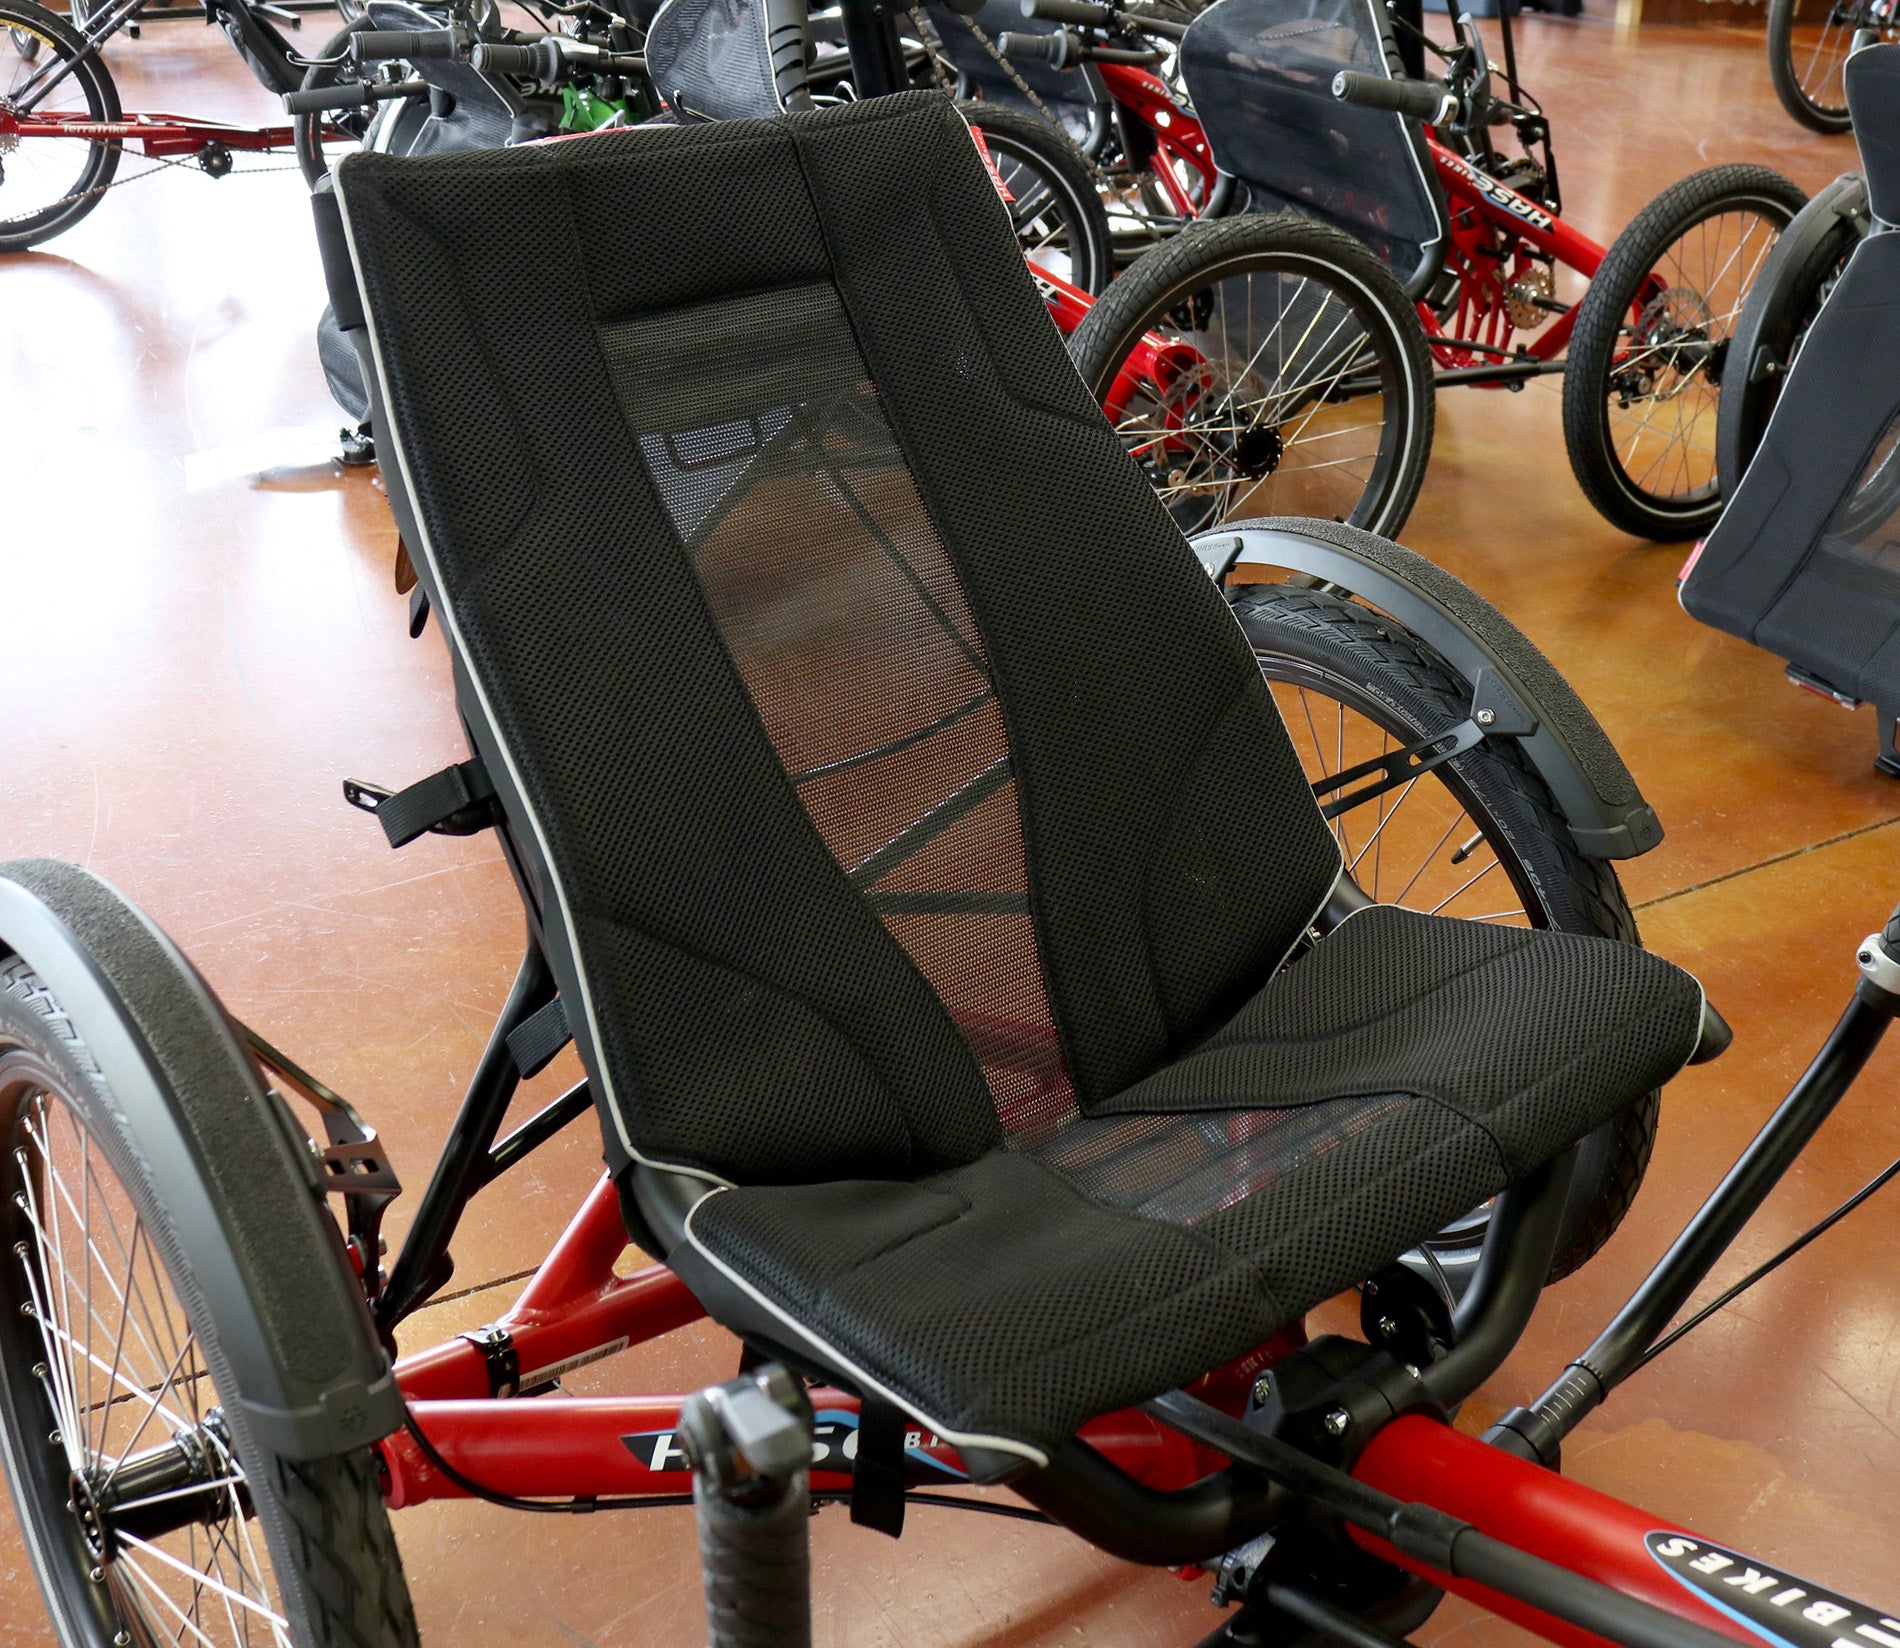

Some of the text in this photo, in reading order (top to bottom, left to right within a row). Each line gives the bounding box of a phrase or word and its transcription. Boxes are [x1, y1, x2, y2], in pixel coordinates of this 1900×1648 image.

[63, 124, 128, 134] TerraTrike
[1439, 155, 1552, 229] HASE BIKES
[1656, 1537, 1852, 1627] BIKES
